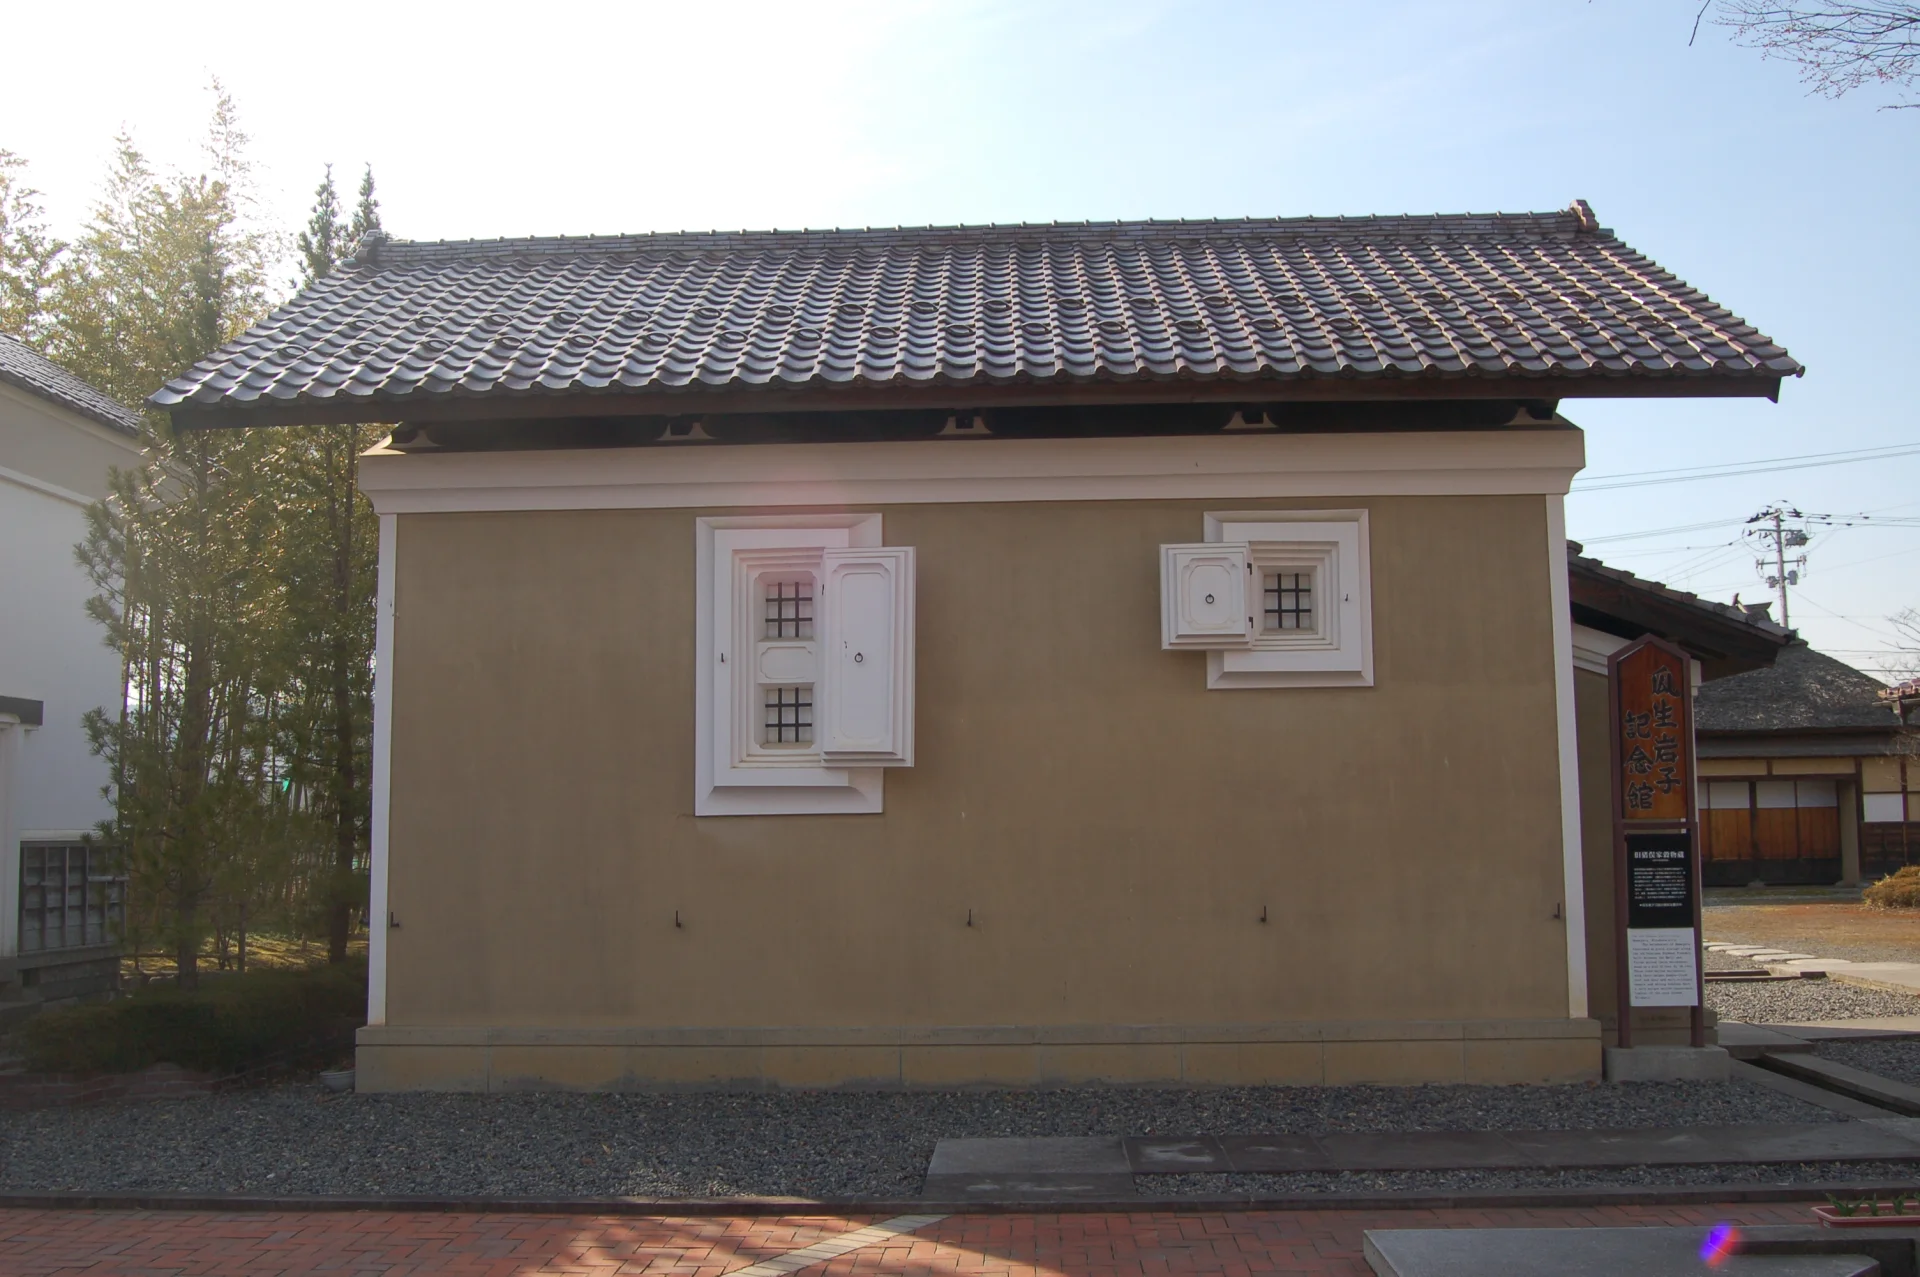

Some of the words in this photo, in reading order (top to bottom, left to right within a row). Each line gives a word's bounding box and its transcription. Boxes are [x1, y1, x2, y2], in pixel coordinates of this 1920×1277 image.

[1623, 710, 1654, 810] 記念館
[1651, 665, 1682, 794] 瓜生岩子
